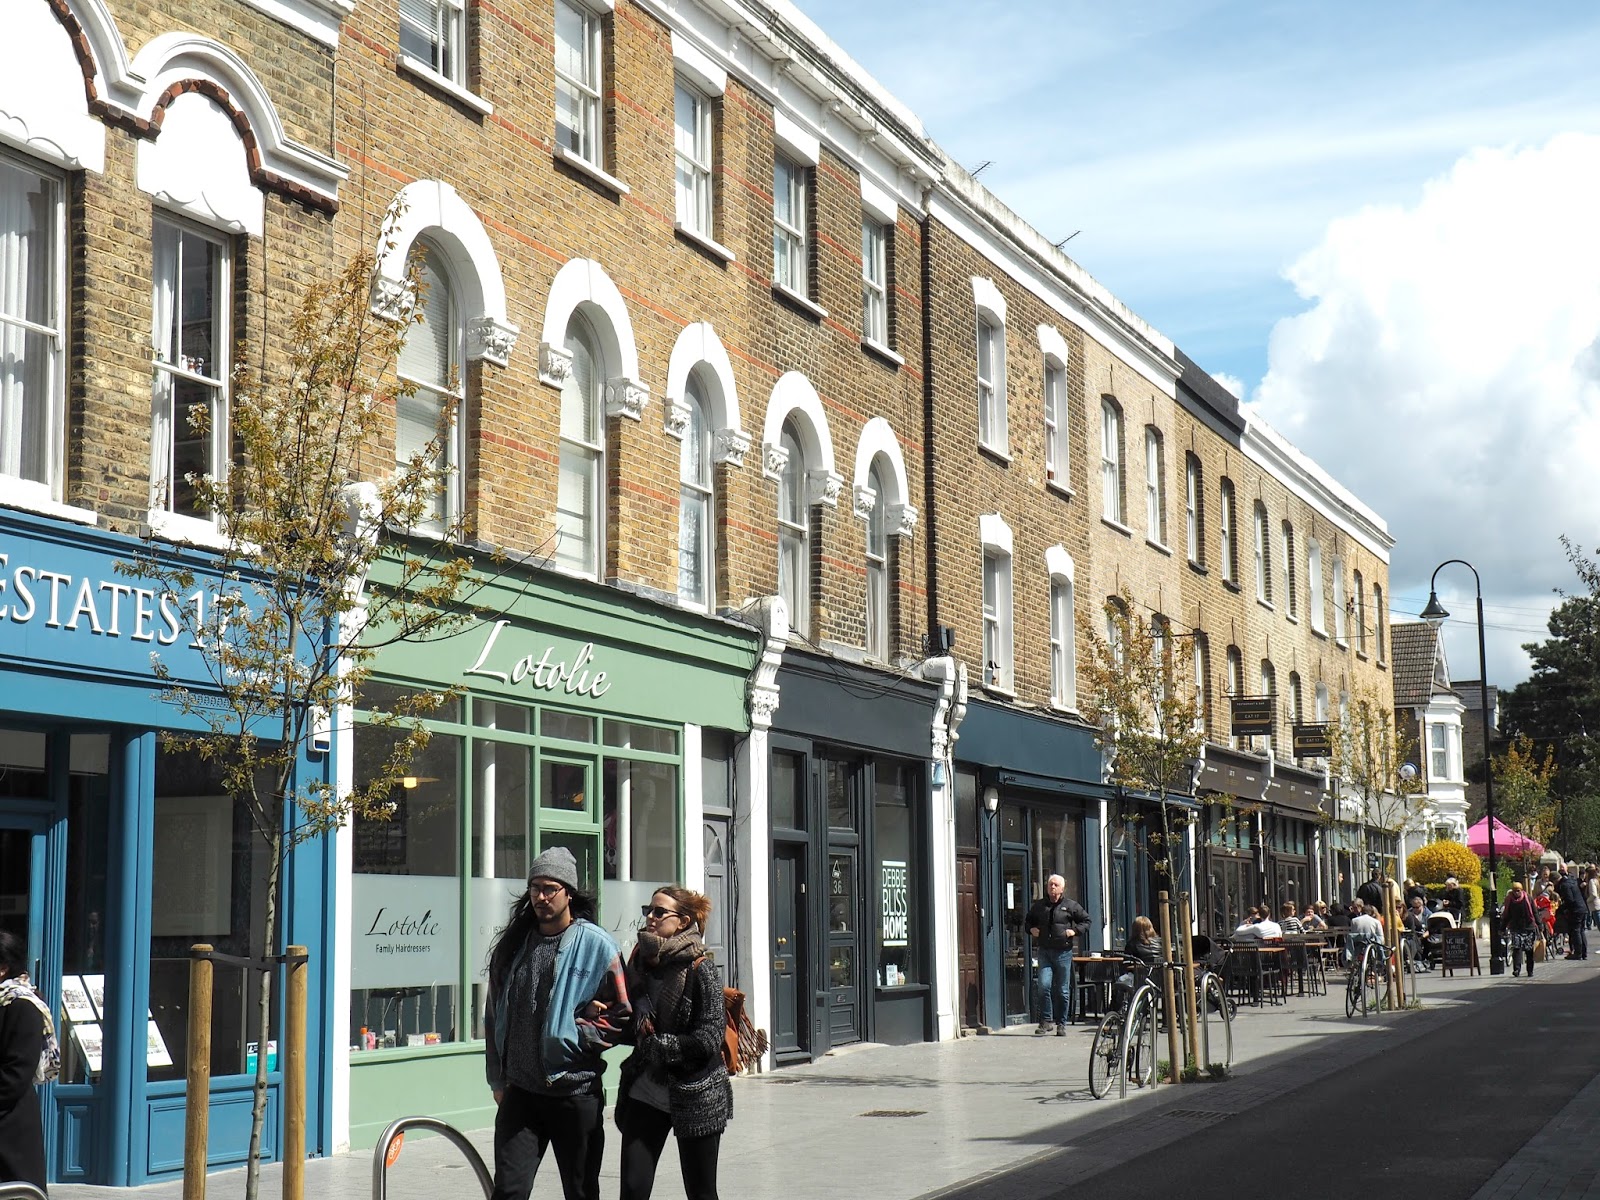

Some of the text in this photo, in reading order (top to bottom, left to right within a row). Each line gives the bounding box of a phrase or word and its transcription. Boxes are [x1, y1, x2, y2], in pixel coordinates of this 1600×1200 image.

[463, 620, 611, 698] Lotolie
[833, 880, 842, 894] 36
[882, 868, 907, 888] DEBBIE
[882, 888, 907, 917] BLISS
[365, 907, 441, 936] Lotolie
[883, 916, 908, 939] HOME
[375, 944, 431, 955] Family Hairdressers
